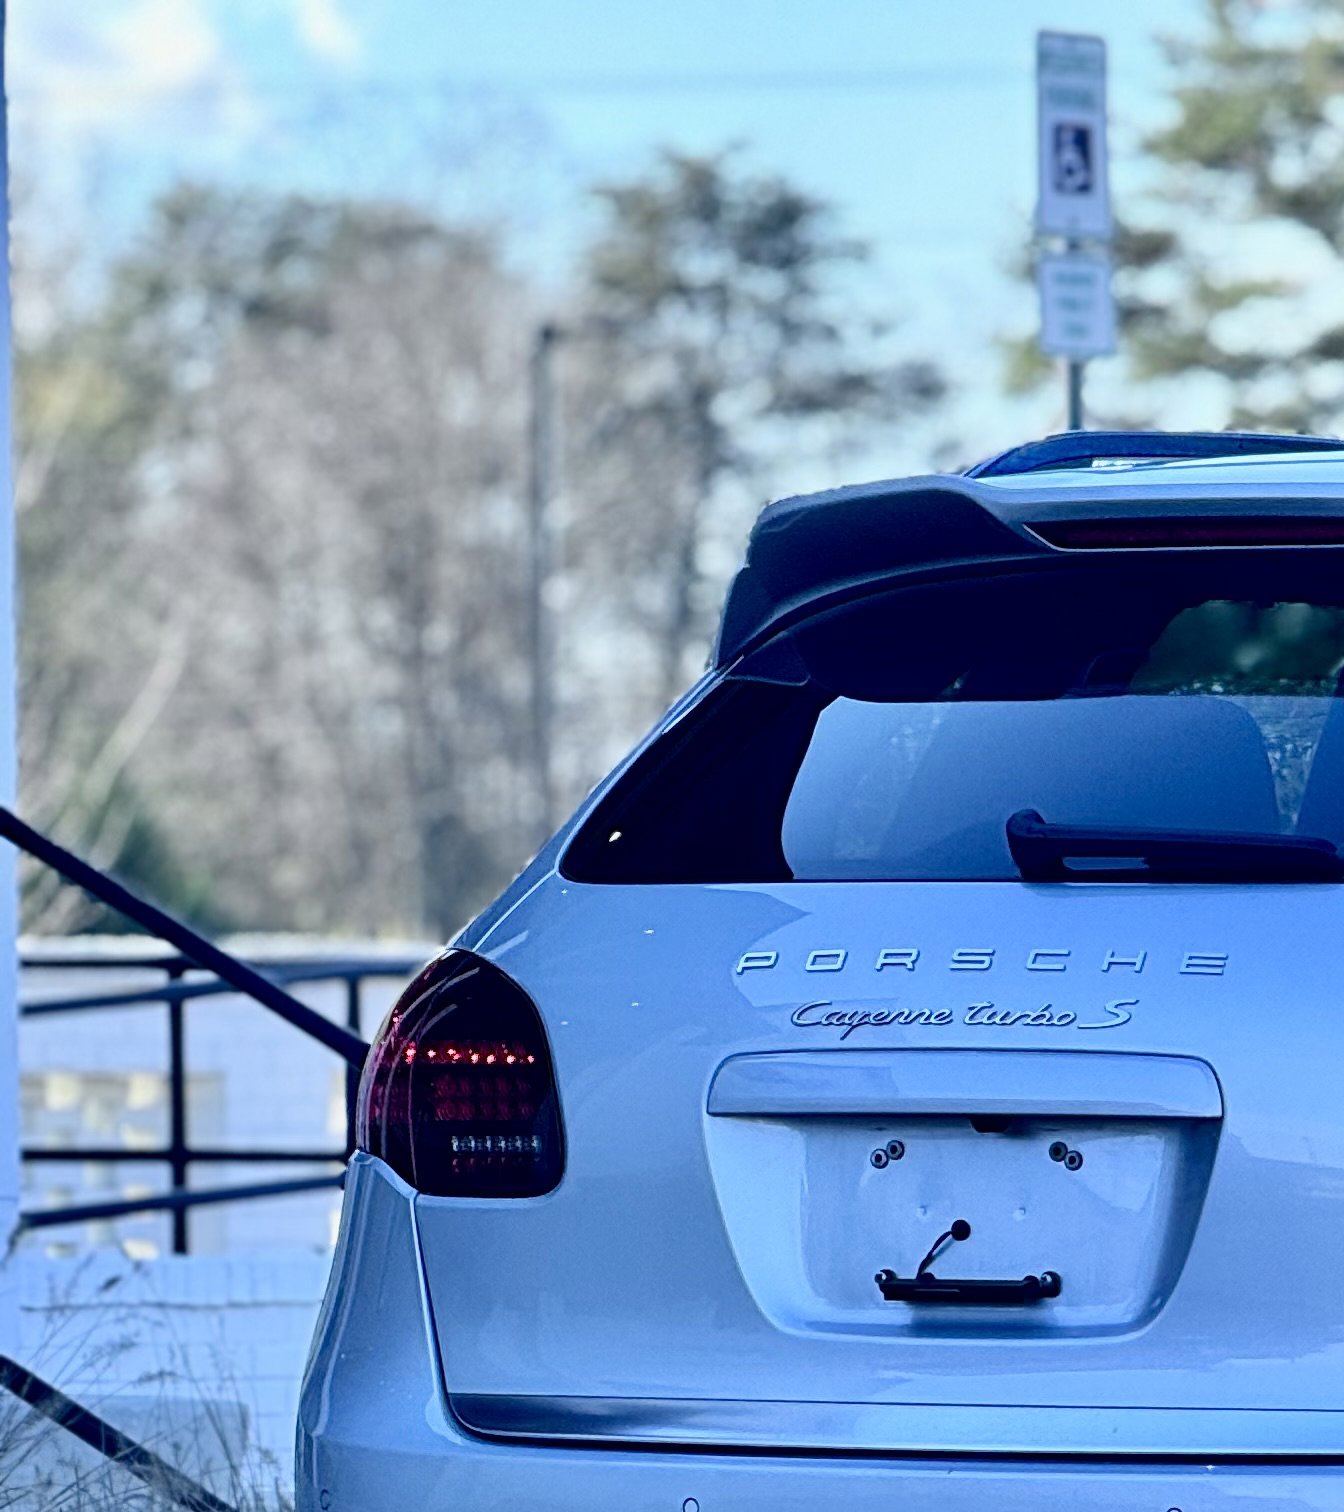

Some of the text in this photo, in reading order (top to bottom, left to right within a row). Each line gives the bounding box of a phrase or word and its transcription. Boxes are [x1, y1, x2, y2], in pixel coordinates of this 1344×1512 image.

[735, 948, 1228, 975] PORSCHE
[790, 1000, 954, 1040] Cayenne
[1077, 998, 1140, 1029] S
